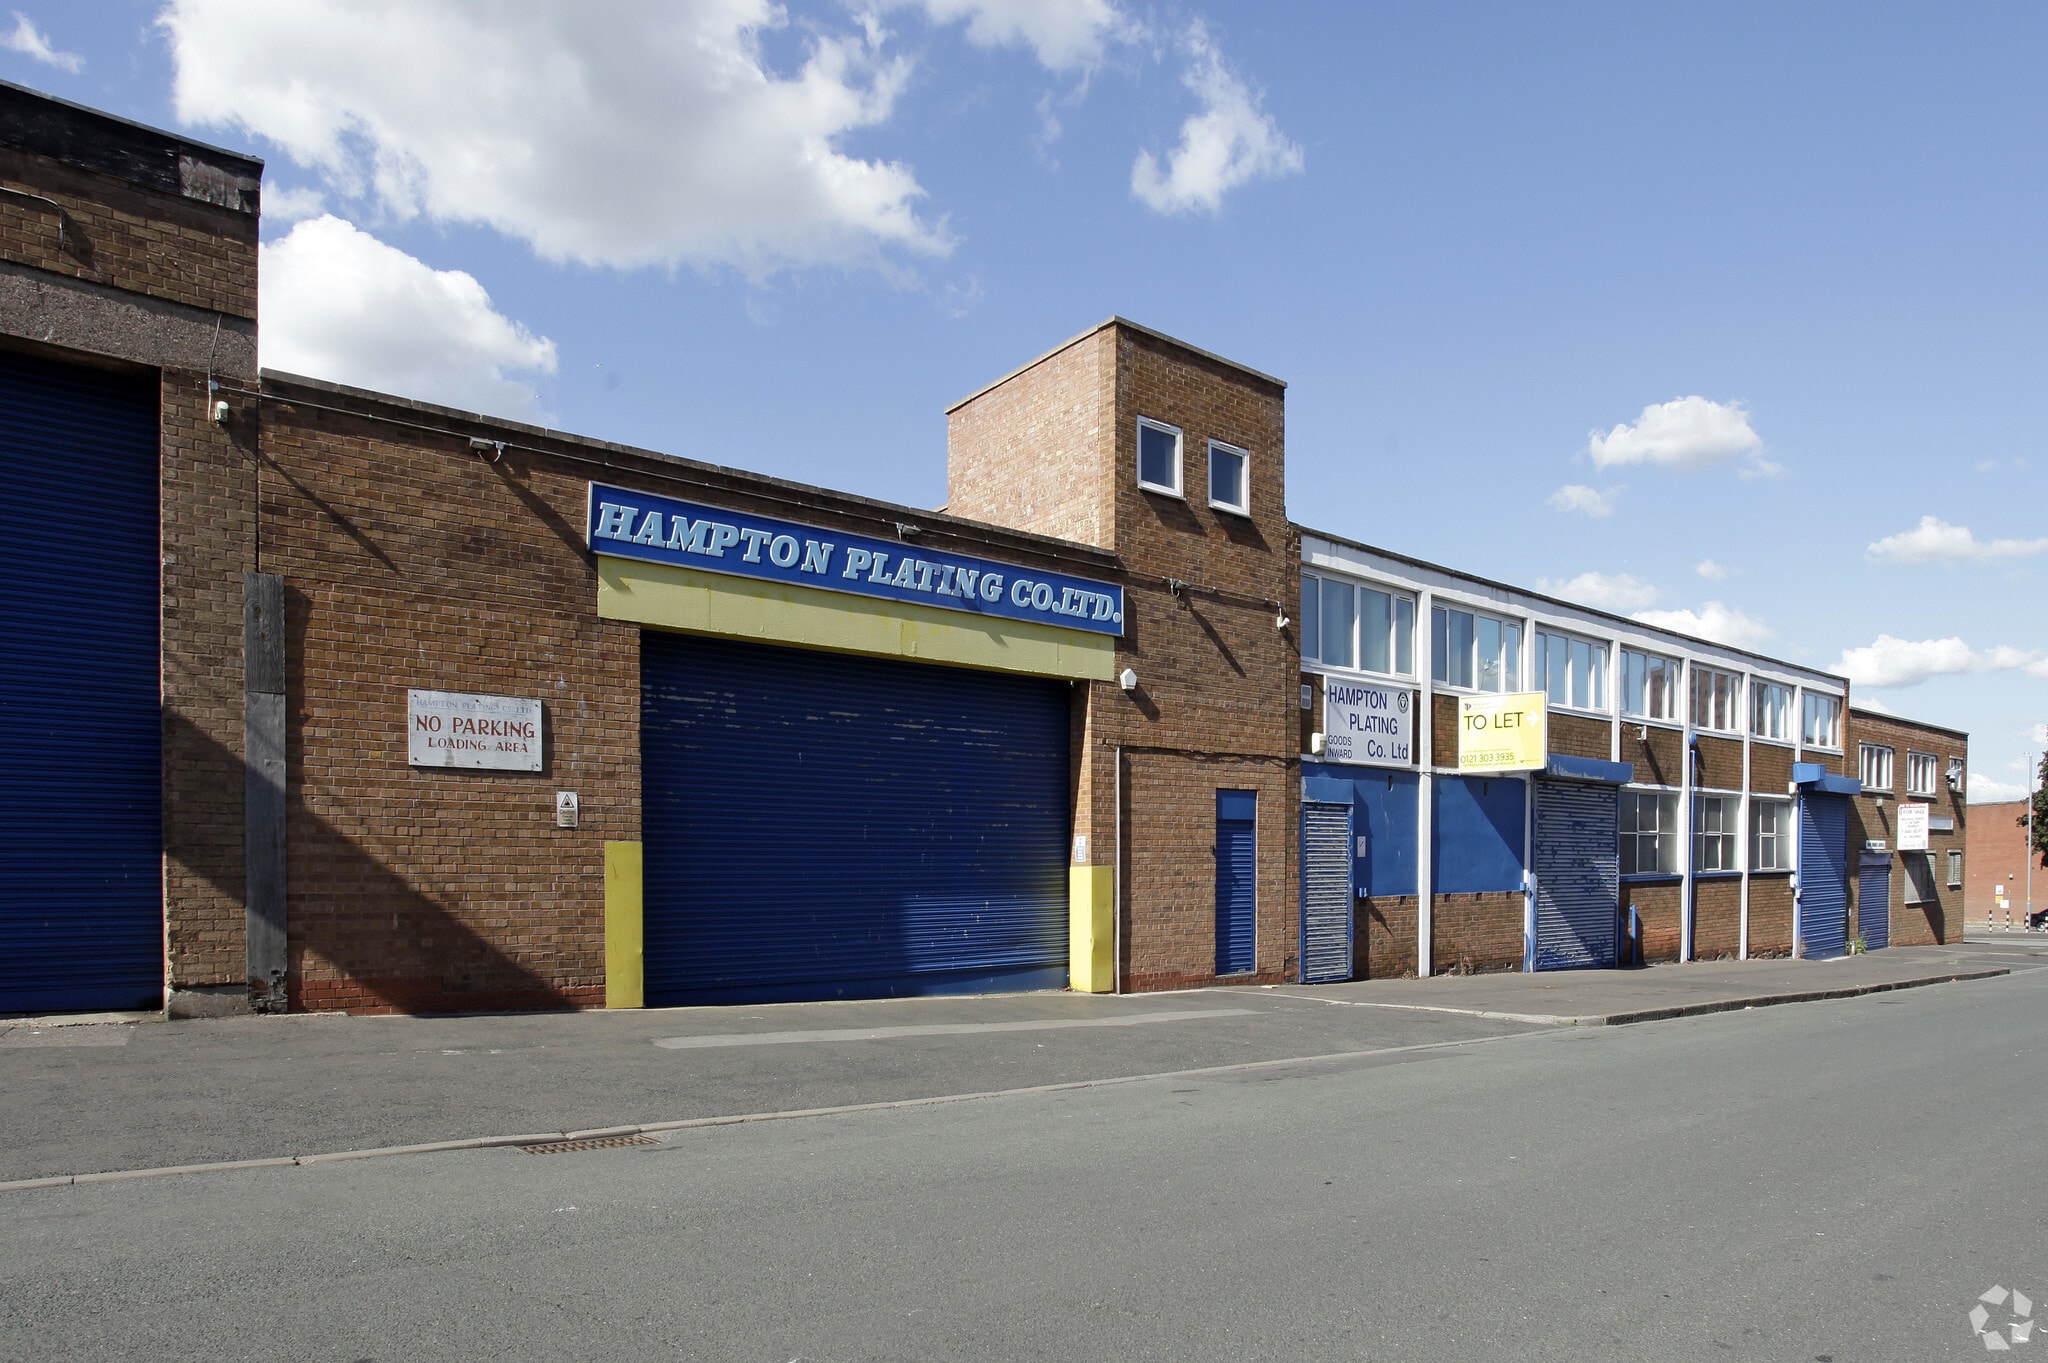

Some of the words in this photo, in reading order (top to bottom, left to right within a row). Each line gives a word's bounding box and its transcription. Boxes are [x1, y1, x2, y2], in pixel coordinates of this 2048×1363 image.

[594, 502, 835, 574] HAMPTON
[842, 547, 1004, 602] PLATING
[1329, 685, 1388, 710] HAMPTON
[416, 715, 442, 732] NO
[452, 717, 535, 739] PARKING
[1349, 713, 1398, 735] PLATING
[1464, 714, 1487, 730] TO
[1494, 712, 1524, 728] LET
[428, 737, 487, 751] LOADING
[495, 741, 529, 753] AREA
[1327, 734, 1352, 746] GOODS
[1367, 739, 1386, 758] Co.
[1391, 742, 1408, 759] Ltd
[1327, 748, 1352, 758] INWARD
[1460, 754, 1477, 764] 0121
[1479, 753, 1494, 763] 303
[1495, 752, 1515, 762] 3935
